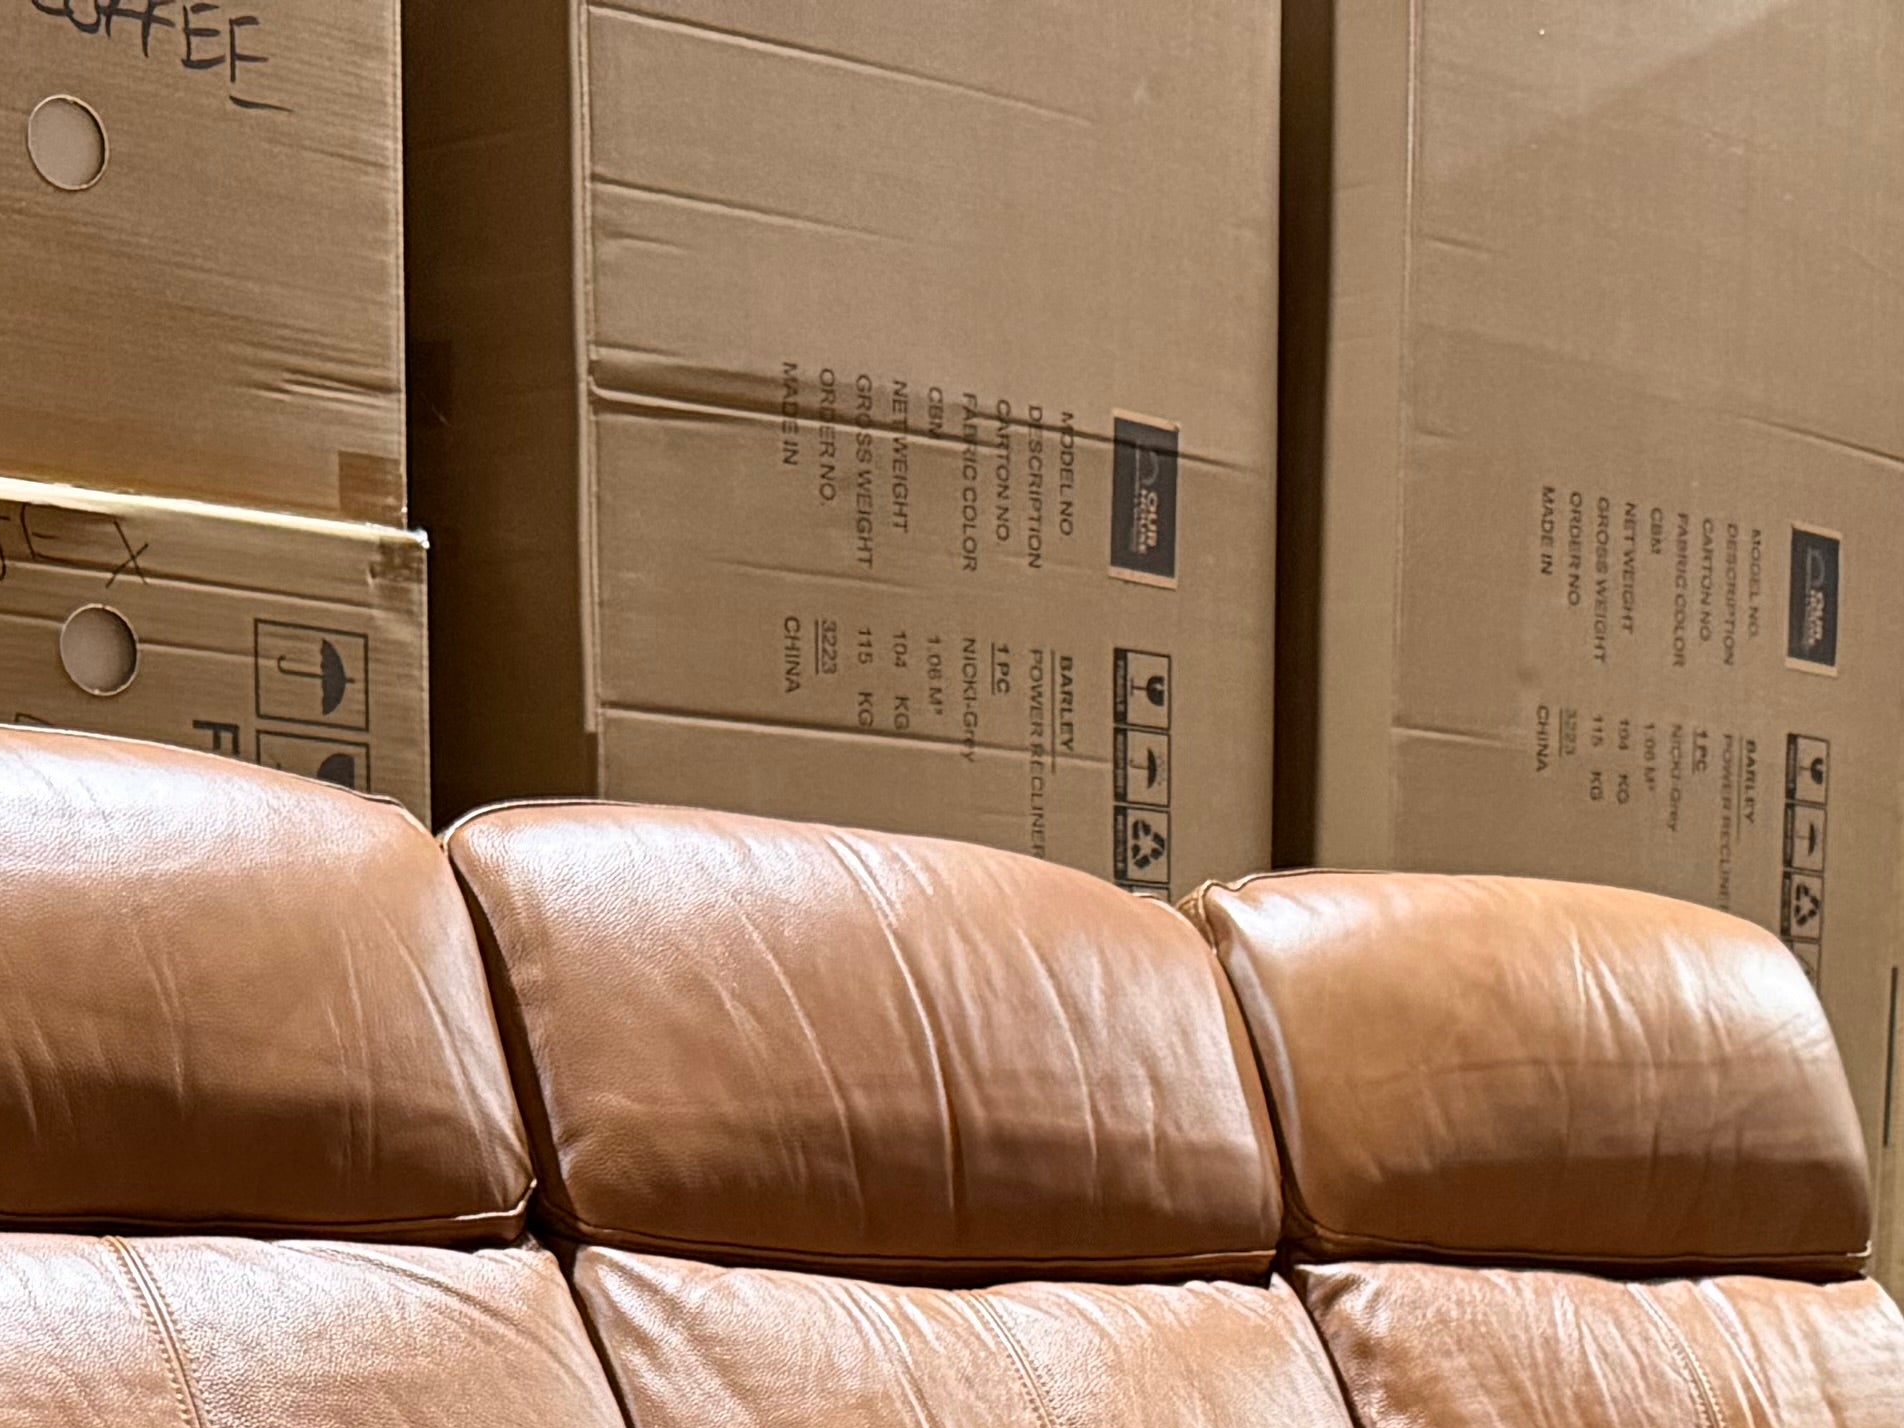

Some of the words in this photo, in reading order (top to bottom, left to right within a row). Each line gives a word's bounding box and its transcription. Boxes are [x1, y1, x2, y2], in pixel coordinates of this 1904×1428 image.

[781, 361, 799, 435] MADE
[818, 368, 837, 459] ORDER
[854, 373, 874, 470] GROSS
[892, 380, 909, 436] NET
[962, 391, 978, 482] FABRIC
[782, 441, 799, 466] IN
[892, 436, 909, 534] WEIGHT
[995, 400, 1012, 501] CARTON
[1027, 404, 1044, 569] DESCRIPTION
[1059, 411, 1075, 497] MODEL
[856, 471, 874, 569] WEIGHT
[962, 488, 978, 573] COLOR
[1541, 485, 1556, 550] MADE
[1567, 490, 1583, 570] ORDER
[1595, 496, 1611, 575] GROSS
[1623, 501, 1637, 543] NET
[1649, 506, 1664, 556] CBM
[1674, 511, 1690, 590] FABRIC
[1540, 553, 1554, 576] IN
[1621, 546, 1637, 635] WEIGHT
[1699, 517, 1714, 606] CARTON
[1723, 522, 1740, 667] DESCRIPTION
[783, 615, 801, 694] CHINA
[820, 619, 838, 675] 3223
[857, 626, 873, 664] 115
[893, 631, 908, 668] 104
[1593, 579, 1609, 665] WEIGHT
[1672, 594, 1689, 669] COLOR
[857, 691, 874, 728] KG
[893, 695, 910, 730] KG
[996, 661, 1010, 695] PC
[1029, 649, 1045, 738] POWER
[1059, 655, 1075, 752] BARLEY
[1535, 704, 1551, 773] CHINA
[1696, 747, 1709, 773] PC
[1589, 771, 1604, 802] KG
[1615, 773, 1631, 806] KG
[1744, 739, 1758, 825] BARLEY
